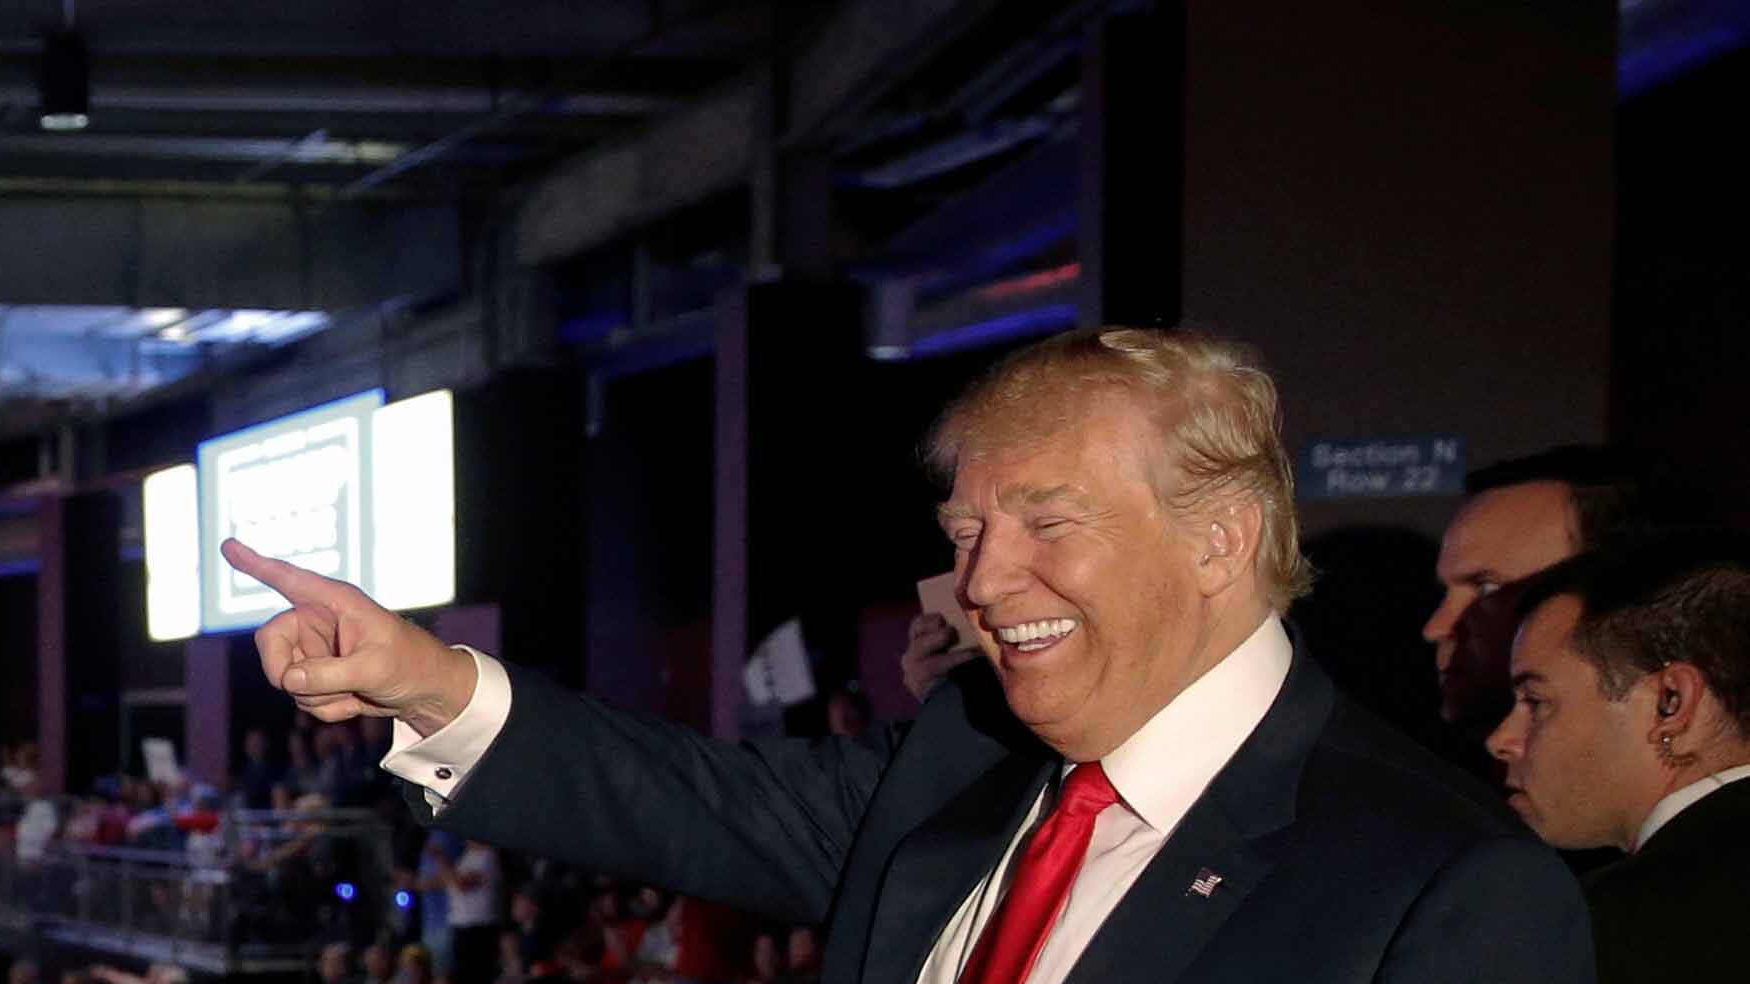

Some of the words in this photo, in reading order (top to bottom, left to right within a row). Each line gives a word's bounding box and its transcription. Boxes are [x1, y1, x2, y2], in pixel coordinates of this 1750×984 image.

[1311, 443, 1420, 468] Section
[1433, 438, 1456, 463] N
[1327, 468, 1386, 493] Row
[1403, 465, 1439, 491] 22
